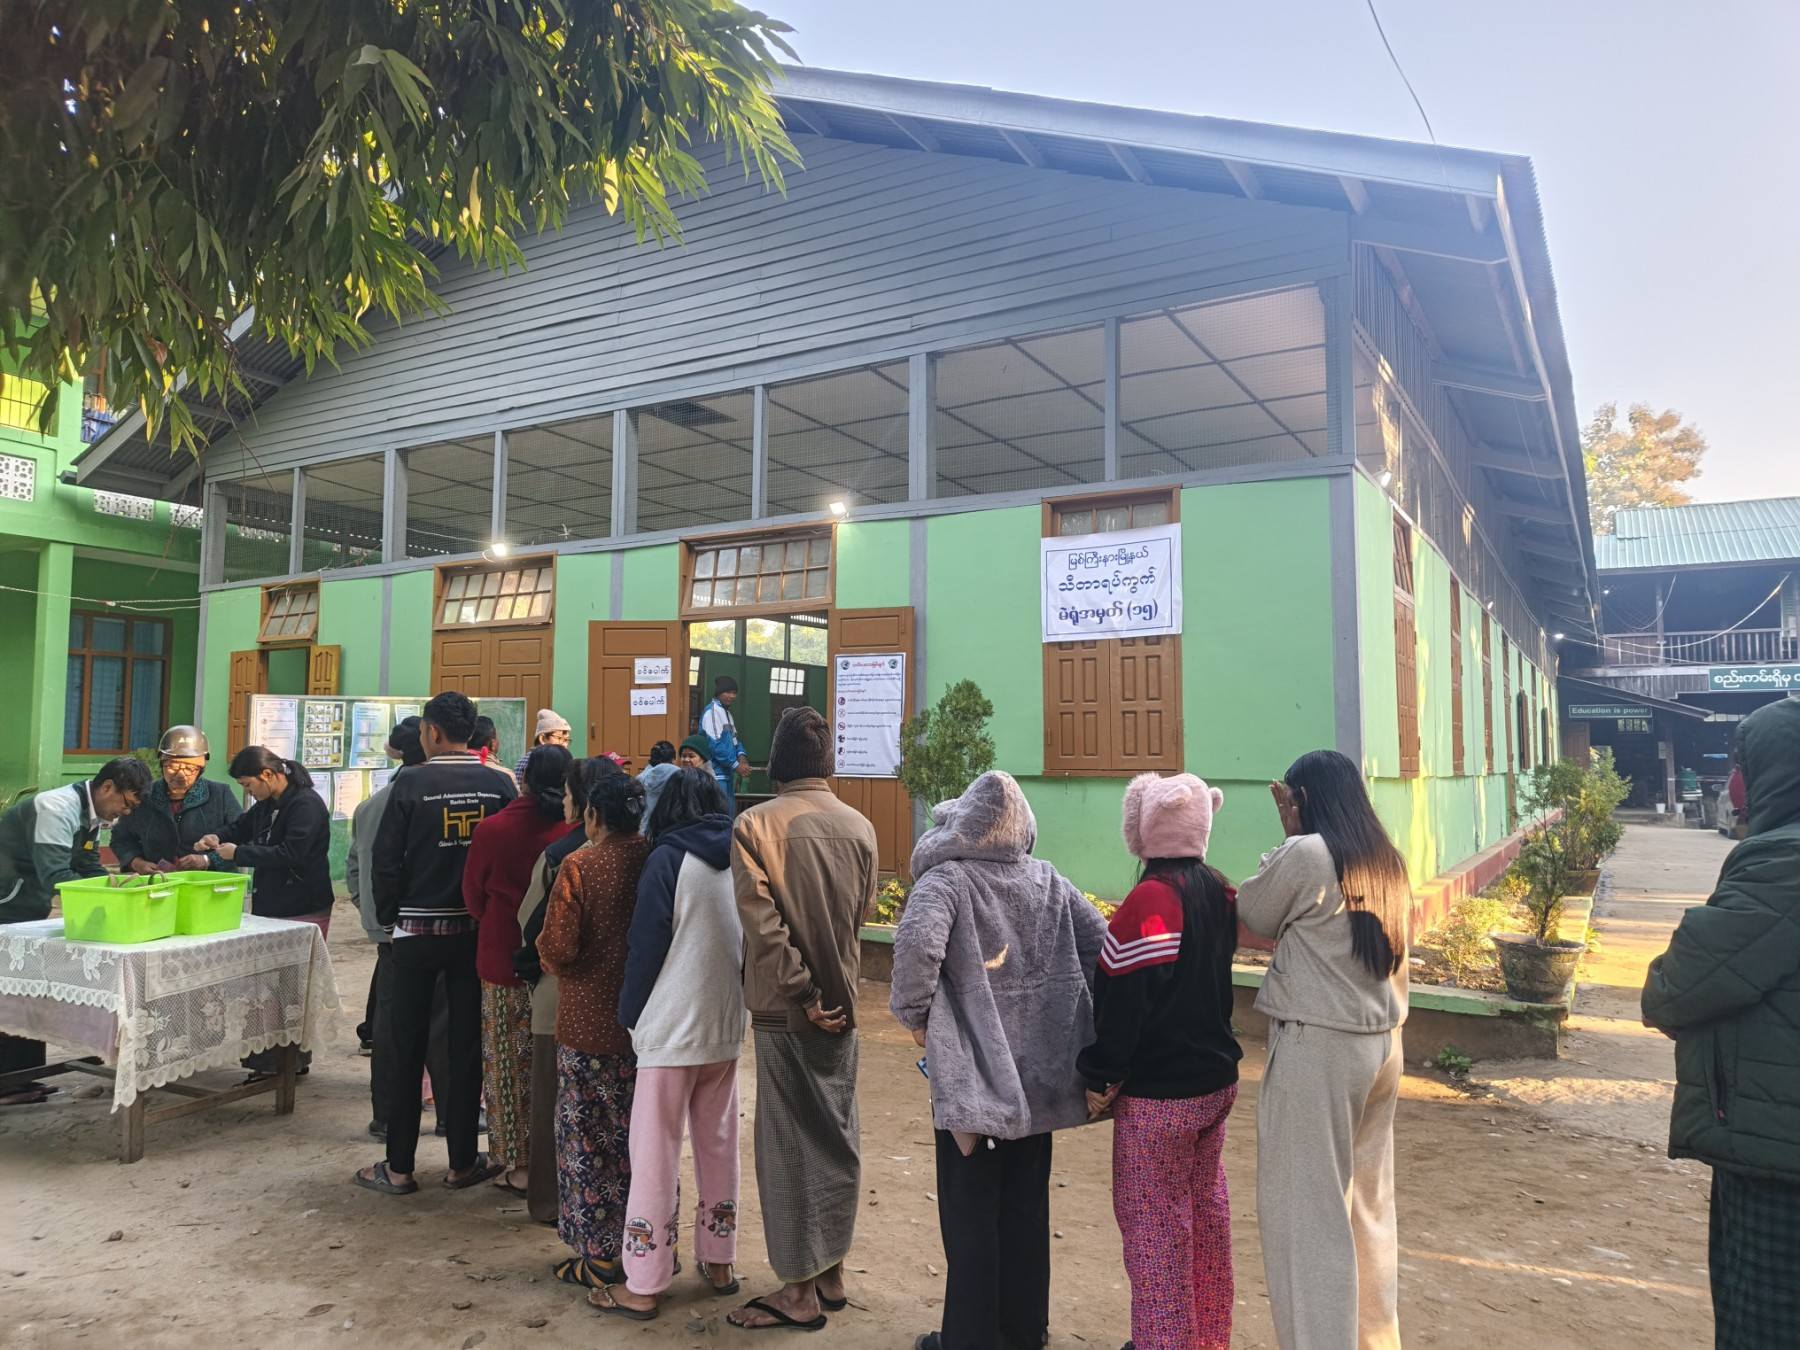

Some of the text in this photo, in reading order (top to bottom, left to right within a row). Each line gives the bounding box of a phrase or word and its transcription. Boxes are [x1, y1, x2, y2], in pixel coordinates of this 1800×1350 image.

[1714, 669, 1791, 688] စည်းကမ်းရှိမှ
